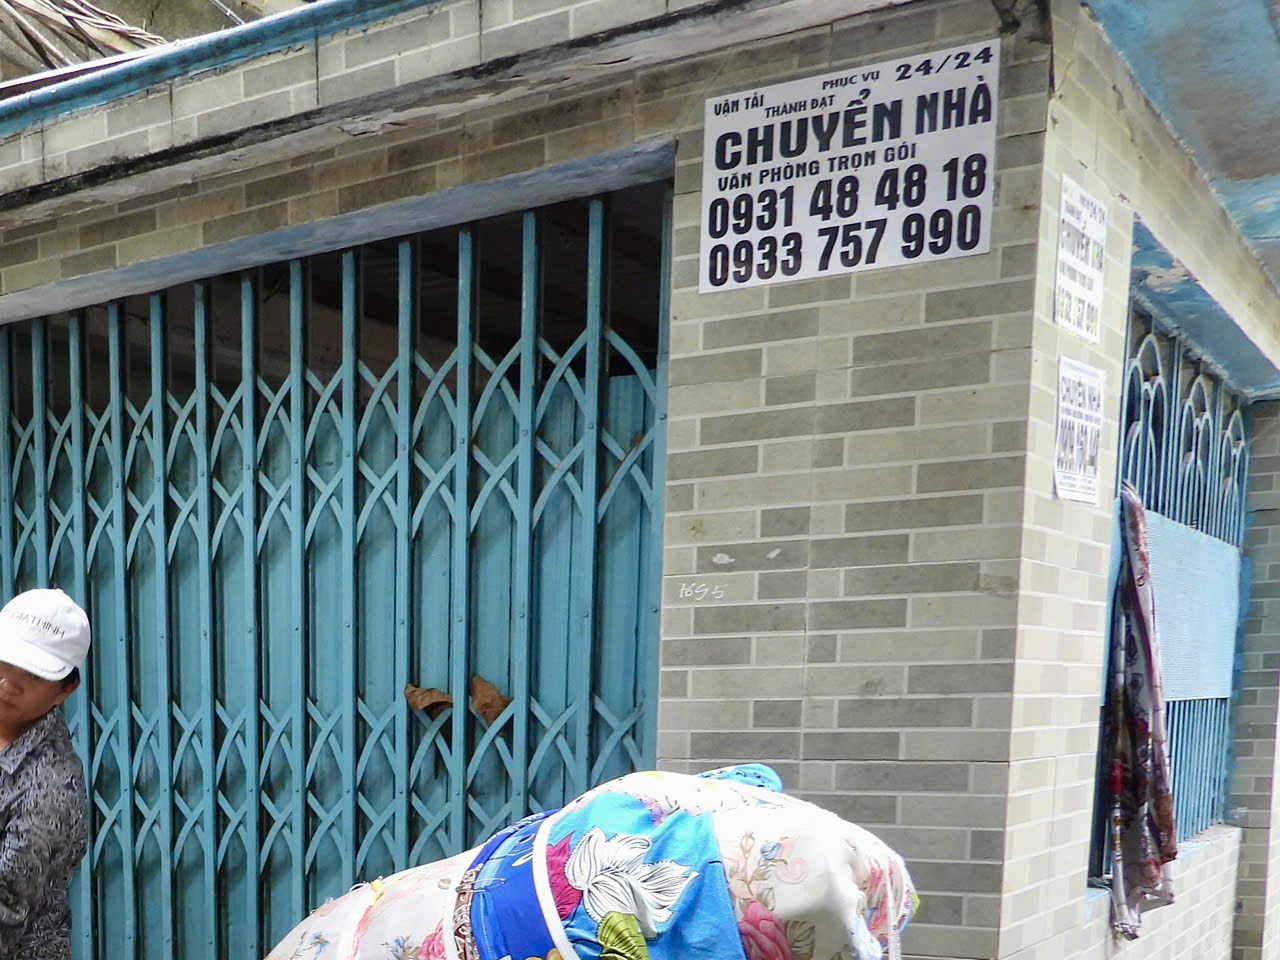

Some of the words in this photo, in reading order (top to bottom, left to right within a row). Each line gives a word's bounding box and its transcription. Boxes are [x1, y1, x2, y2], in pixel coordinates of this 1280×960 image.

[822, 75, 858, 90] PHỤC
[862, 70, 880, 82] VỤ
[895, 46, 994, 82] 24/24
[714, 88, 903, 171] CHUYỂN
[915, 74, 992, 136] NHÀ
[744, 92, 764, 111] TẢI
[765, 100, 807, 119] THÀNH
[810, 94, 836, 111] ĐẠT
[718, 173, 752, 192] VĂN
[759, 160, 820, 186] PHÒNG
[828, 149, 876, 174] TRỌN
[884, 141, 917, 162] GÓI
[708, 185, 795, 240] 0931
[809, 174, 860, 222] 48
[874, 163, 928, 212] 48
[942, 152, 988, 202] 18
[708, 231, 803, 287] 0933
[817, 218, 888, 272] 757
[900, 203, 982, 260] 990
